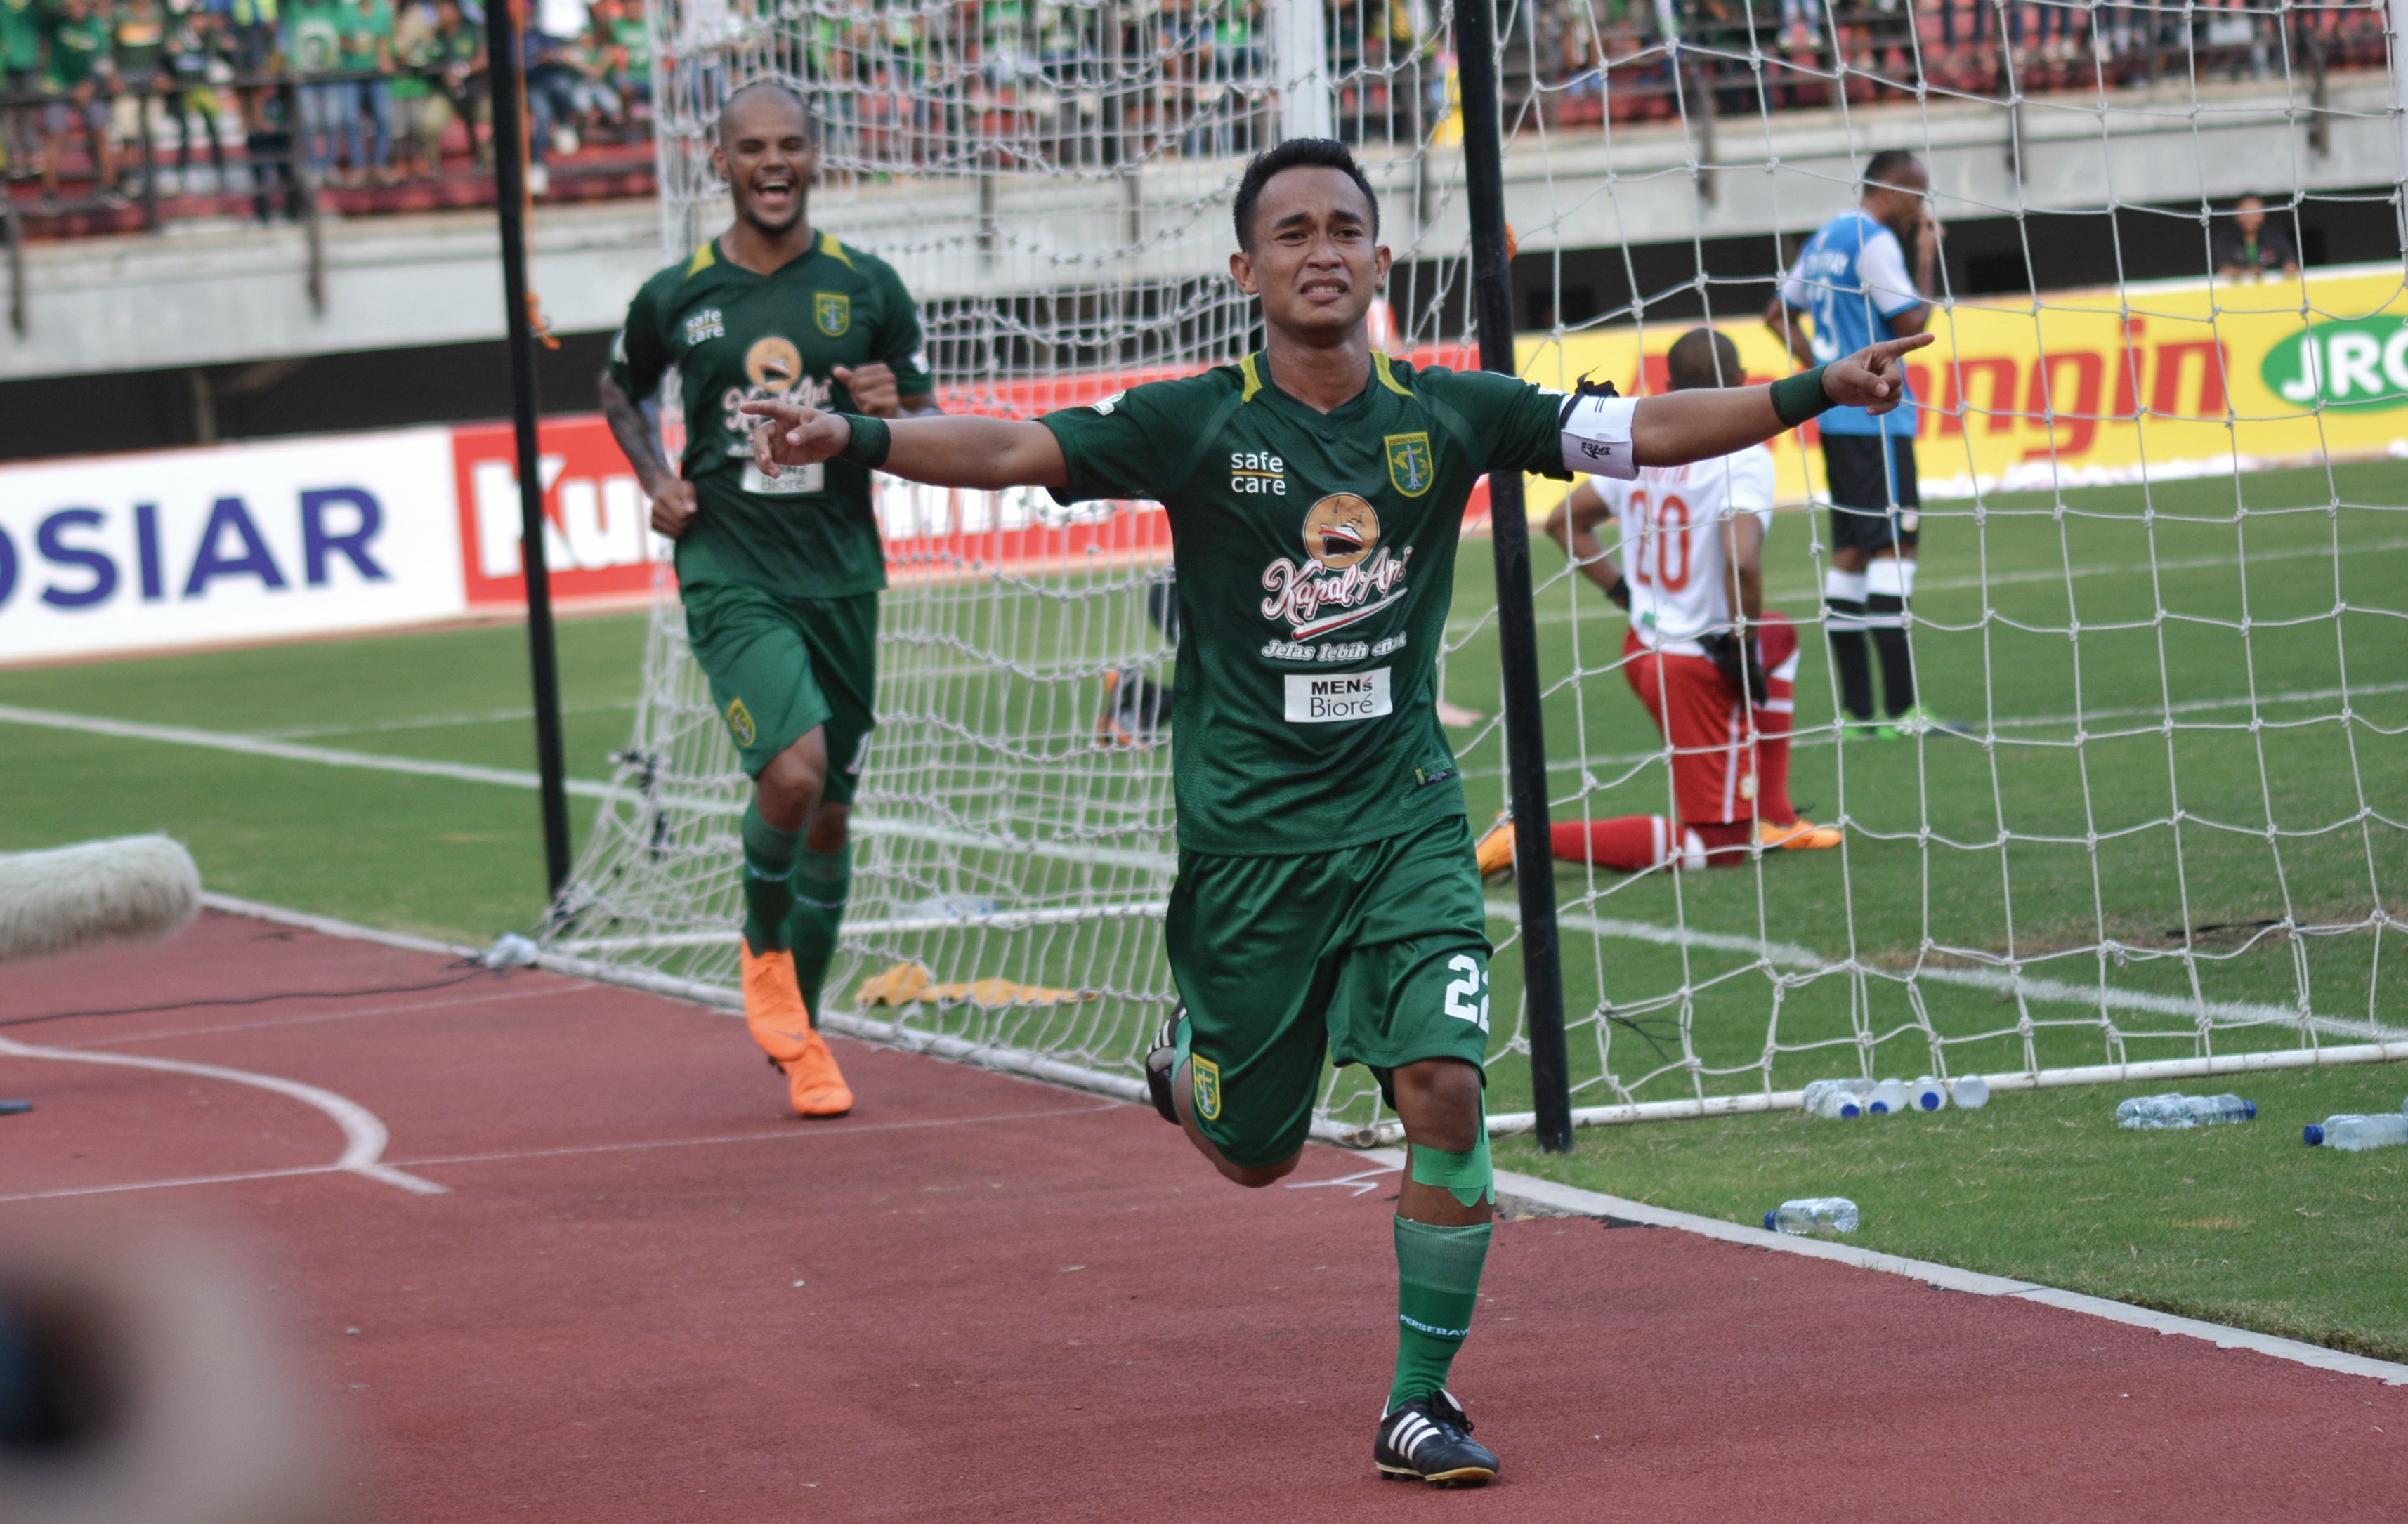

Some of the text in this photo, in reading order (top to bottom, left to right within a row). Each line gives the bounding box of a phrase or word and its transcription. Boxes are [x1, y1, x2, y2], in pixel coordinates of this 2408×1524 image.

[686, 309, 722, 329] safe
[688, 326, 725, 346] care
[1389, 435, 1425, 445] PERSEBAYA
[1581, 442, 1612, 454] SPECS
[1231, 452, 1284, 473] safe
[1231, 476, 1287, 496] care
[0, 486, 393, 612] SIAR
[1630, 490, 1691, 595] 20
[1262, 546, 1414, 626] Kapal Api
[1262, 639, 1316, 661] Jelas
[1317, 641, 1370, 662] lebih
[1309, 693, 1374, 718] Bioré
